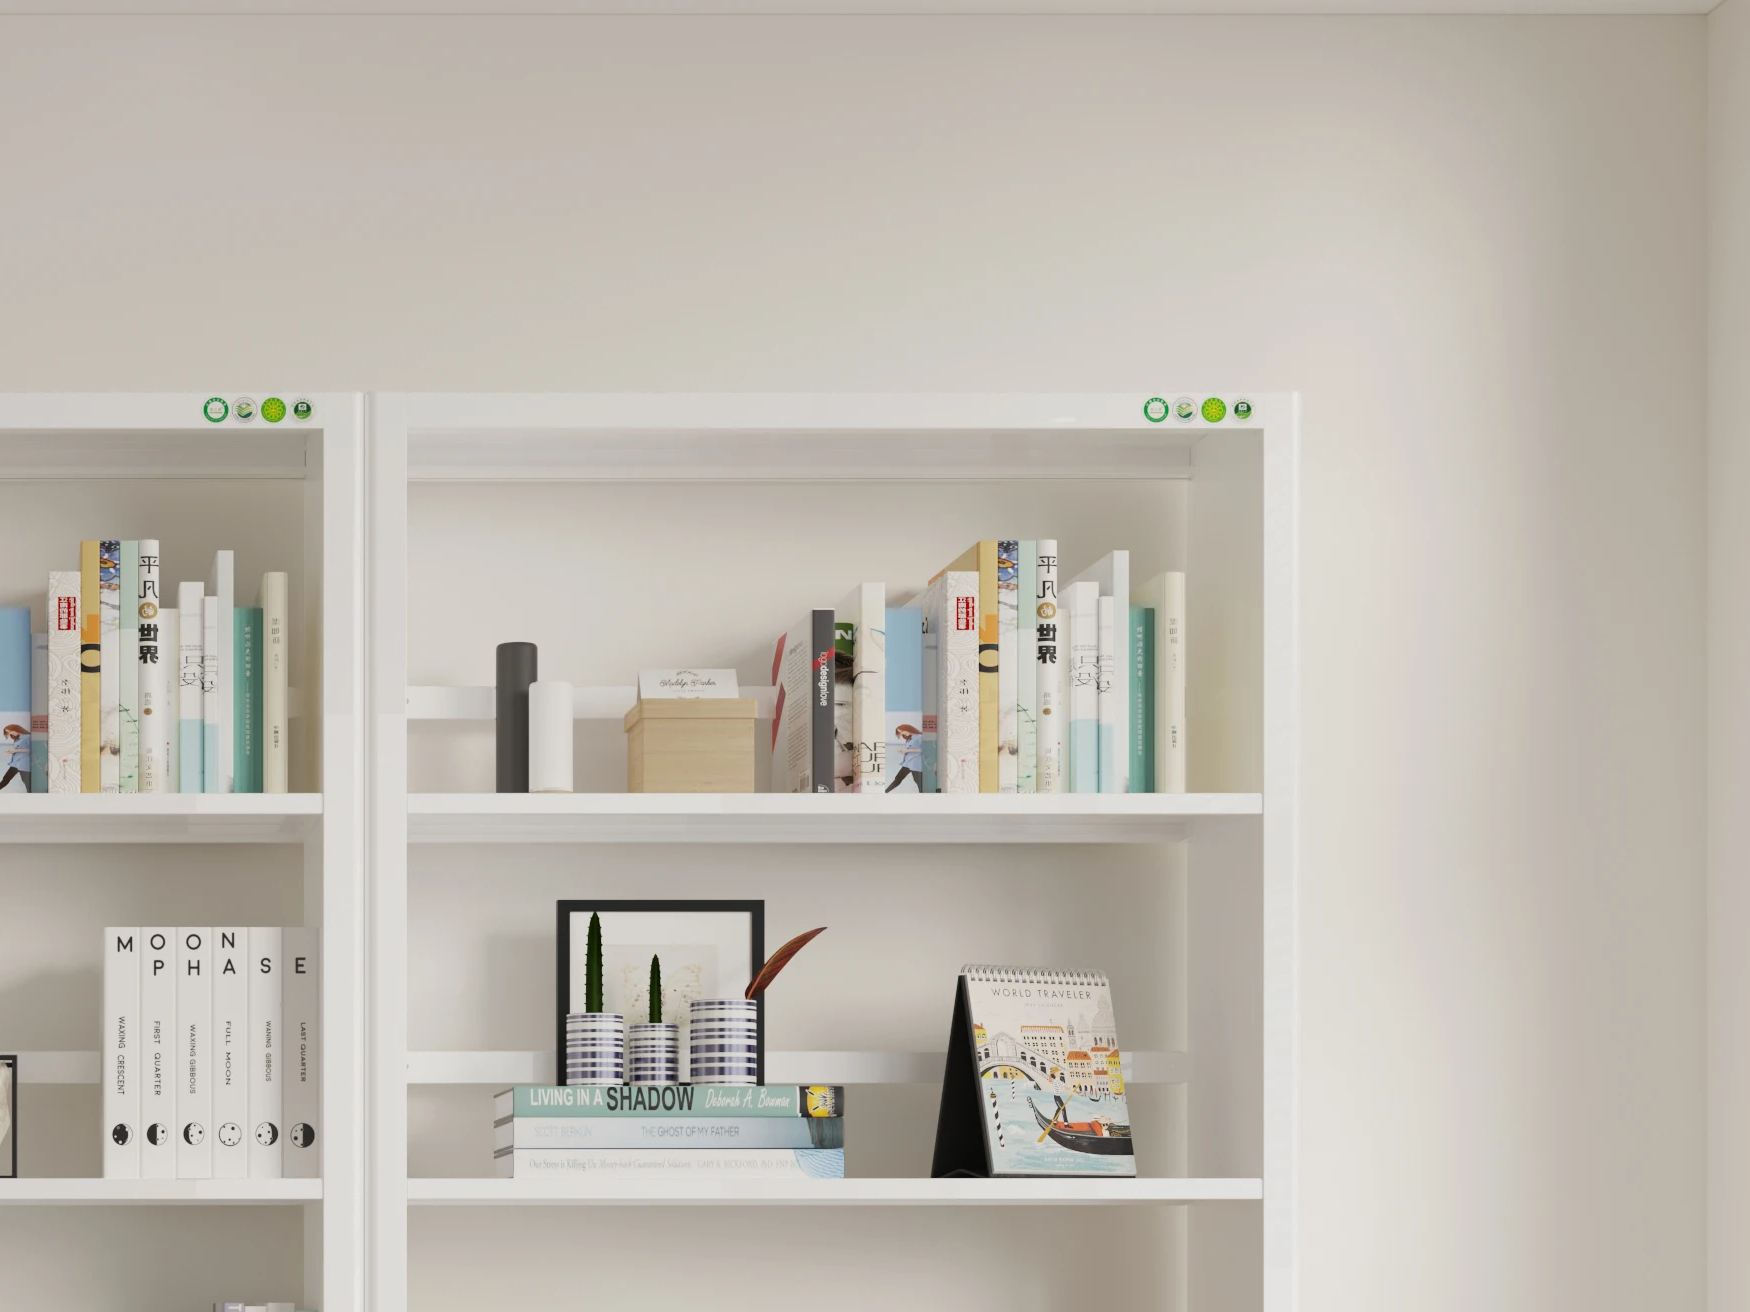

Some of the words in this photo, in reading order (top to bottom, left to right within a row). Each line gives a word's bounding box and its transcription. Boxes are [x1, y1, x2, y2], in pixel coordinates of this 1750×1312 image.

[991, 988, 1031, 997] WORLD
[1037, 990, 1092, 999] TRAVELER
[118, 1016, 126, 1048] WAXING
[117, 1055, 125, 1095] CRESCENT
[530, 1088, 573, 1106] LIVING
[577, 1088, 591, 1105] IN
[593, 1088, 603, 1105] A
[606, 1086, 694, 1111] SHADOW
[706, 1088, 740, 1108] Deborah
[657, 1126, 684, 1137] GHOST
[685, 1126, 697, 1137] OF
[697, 1126, 709, 1137] MY
[710, 1126, 740, 1137] FATHER
